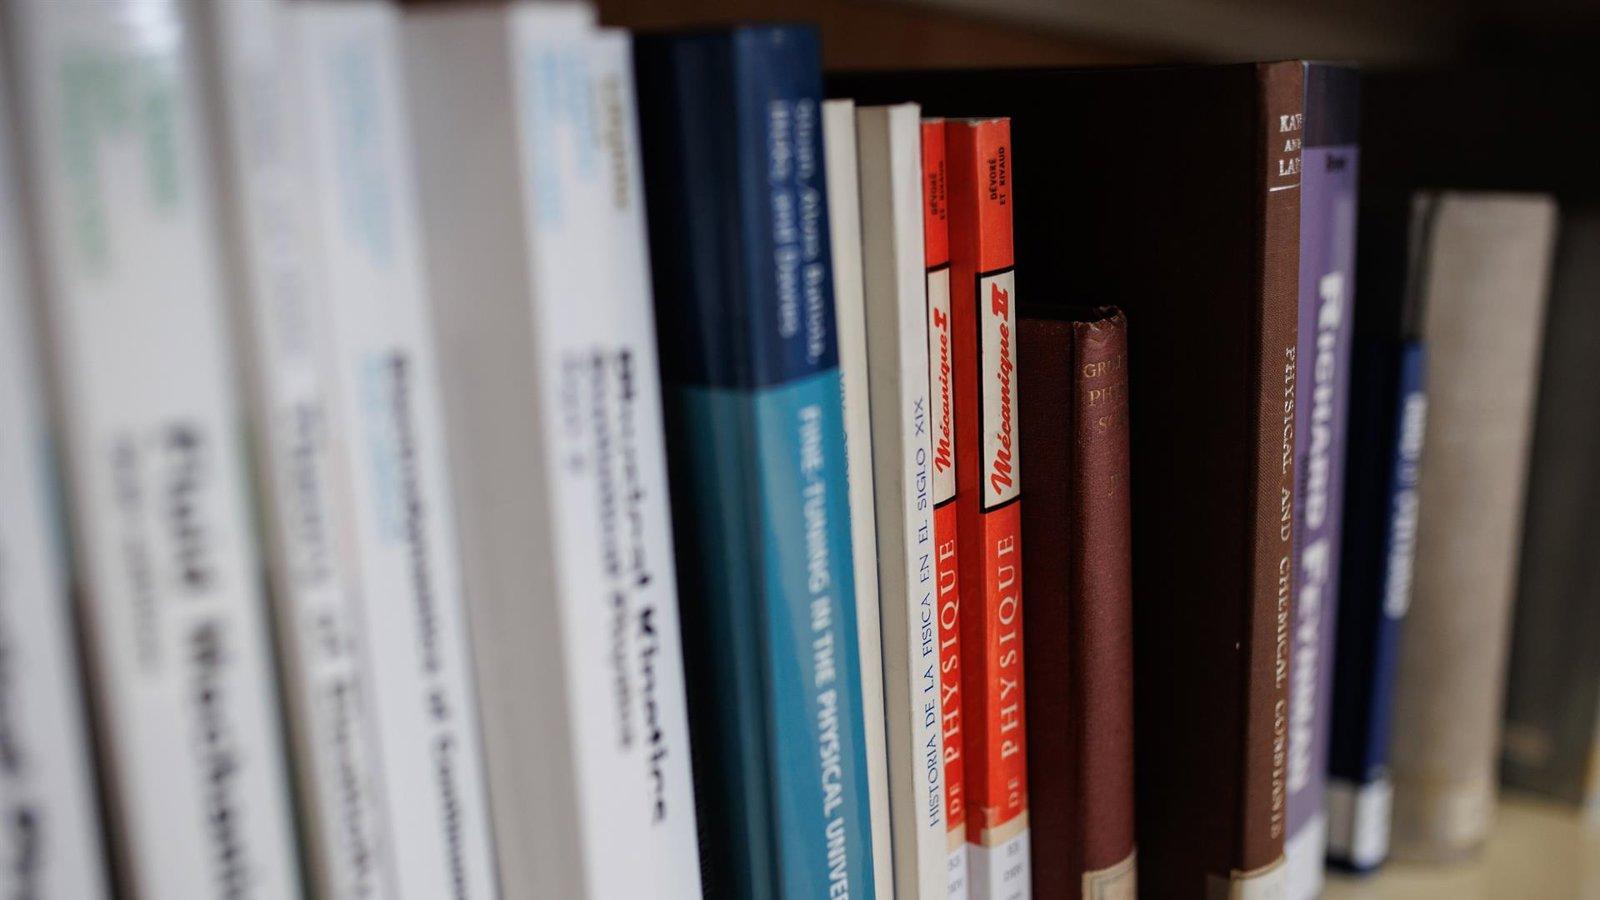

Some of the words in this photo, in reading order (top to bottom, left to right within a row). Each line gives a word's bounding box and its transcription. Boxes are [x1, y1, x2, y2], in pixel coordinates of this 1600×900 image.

[987, 158, 997, 200] DÉVORÉ
[998, 146, 1006, 186] RIVAUD
[999, 194, 1006, 206] ET
[933, 307, 948, 332] I
[992, 282, 1009, 322] II
[914, 397, 924, 437] XIX
[934, 334, 952, 473] Mécanique
[991, 324, 1013, 495] Mécanique
[1282, 346, 1296, 475] PHYSICAL
[1304, 270, 1346, 531] RICHARD
[799, 405, 831, 594] FINE-TUNING
[915, 447, 927, 511] SIGLO
[918, 519, 928, 544] EL
[1280, 486, 1292, 542] AND
[919, 554, 931, 583] EN
[810, 595, 832, 633] IN
[920, 592, 934, 658] FISICA
[1276, 557, 1291, 689] CHEMICAL
[813, 631, 836, 688] THE
[940, 539, 960, 767] PHYSIQUE
[998, 535, 1019, 760] PHYSIQUE
[1286, 540, 1332, 794] FEYNMAN
[923, 664, 934, 693] LA
[925, 698, 936, 728] DE
[817, 688, 843, 817] PHYSICAL
[926, 734, 941, 827] HISTORIA
[949, 783, 961, 815] DE
[1008, 778, 1019, 808] DE
